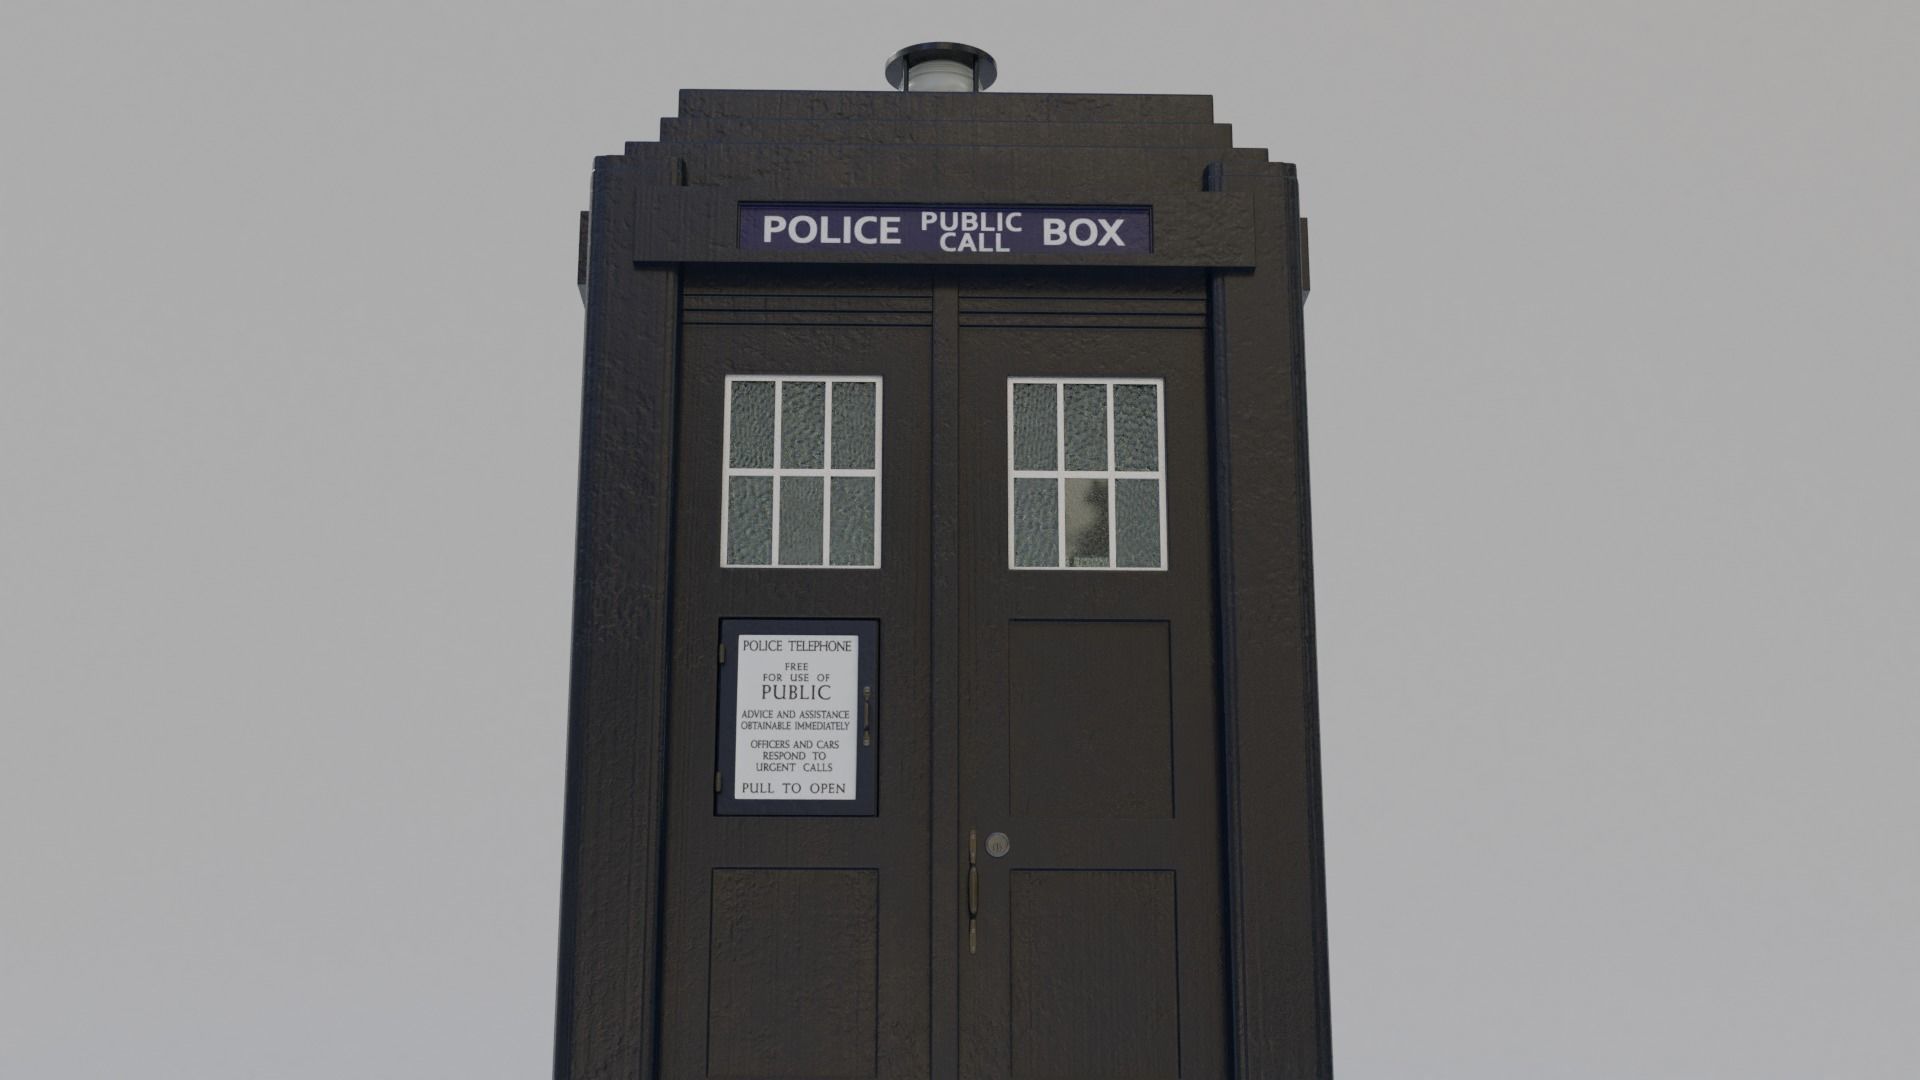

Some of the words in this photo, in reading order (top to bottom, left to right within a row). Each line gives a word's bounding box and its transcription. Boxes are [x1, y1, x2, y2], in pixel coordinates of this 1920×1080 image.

[921, 212, 1022, 233] PUBLIC
[763, 215, 901, 244] POLICE
[1042, 218, 1125, 247] BOX
[940, 232, 1010, 252] CALL
[743, 640, 782, 652] POLICE
[788, 640, 852, 652] TELEPHONE
[785, 663, 808, 671] FREE
[763, 674, 783, 682] FOR
[791, 674, 809, 682] USE
[817, 674, 830, 682] OF
[762, 685, 831, 700] PUBLIC
[742, 710, 774, 718] ADVICE
[777, 710, 796, 718] AND
[799, 710, 850, 719] ASSISTANCE
[741, 721, 791, 730] OBTAINABLE
[795, 721, 850, 731] IMMEDIATELY
[750, 740, 790, 748] OFFICERS
[793, 740, 813, 749] AND
[817, 740, 839, 749] CARS
[763, 752, 806, 760] RESPOND
[813, 752, 826, 760] TO
[756, 763, 796, 772] URGENT
[803, 763, 833, 772] CALLS
[742, 783, 774, 793] PULL
[782, 783, 802, 793] TO
[809, 783, 846, 794] OPEN
